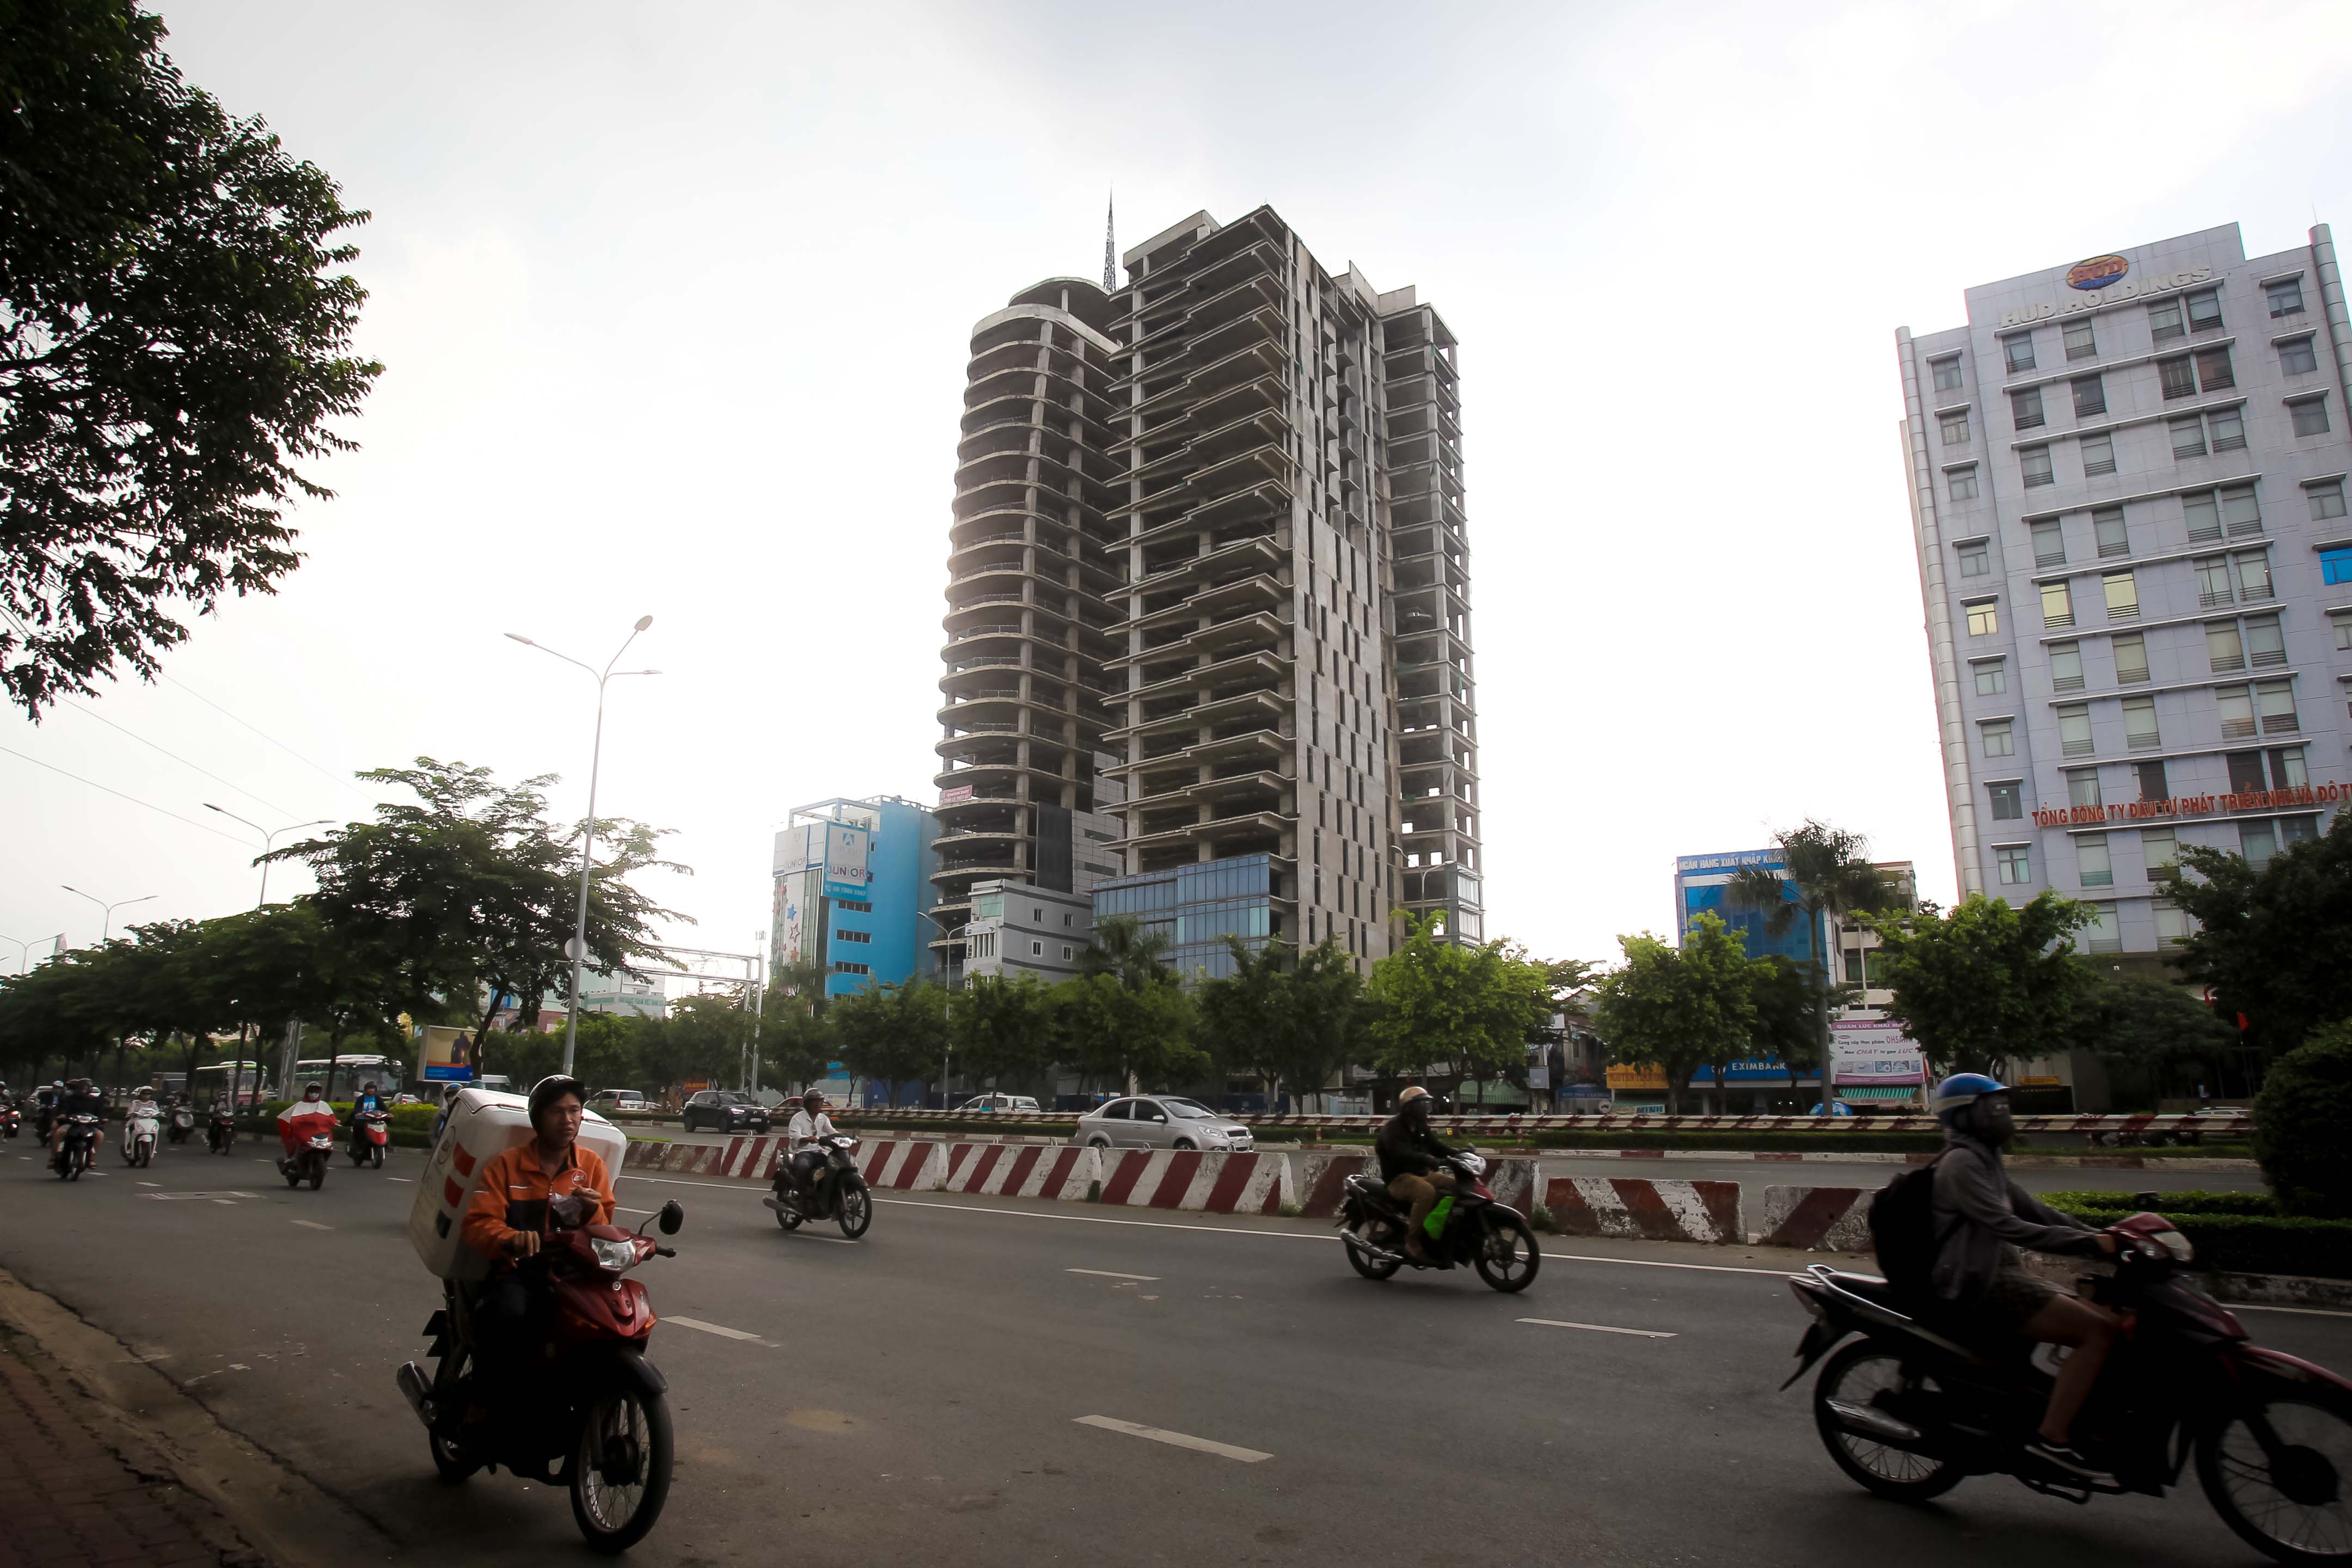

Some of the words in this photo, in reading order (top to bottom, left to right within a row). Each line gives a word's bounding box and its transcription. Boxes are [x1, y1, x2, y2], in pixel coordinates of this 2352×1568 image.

[2072, 261, 2123, 283] HUD
[2001, 303, 2057, 328] HUD
[2063, 266, 2212, 314] HOLDINGS
[2032, 801, 2067, 826] TỔNG
[2071, 803, 2105, 824] CÔNG
[2108, 804, 2126, 820] TY
[2129, 793, 2157, 818] ĐẦU
[2160, 795, 2177, 815] TƯ
[2181, 792, 2215, 815] PHÁT
[2317, 780, 2338, 801] ĐÔ
[826, 863, 866, 878] JUNIOR
[1732, 1062, 1786, 1070] EXIMBANK
